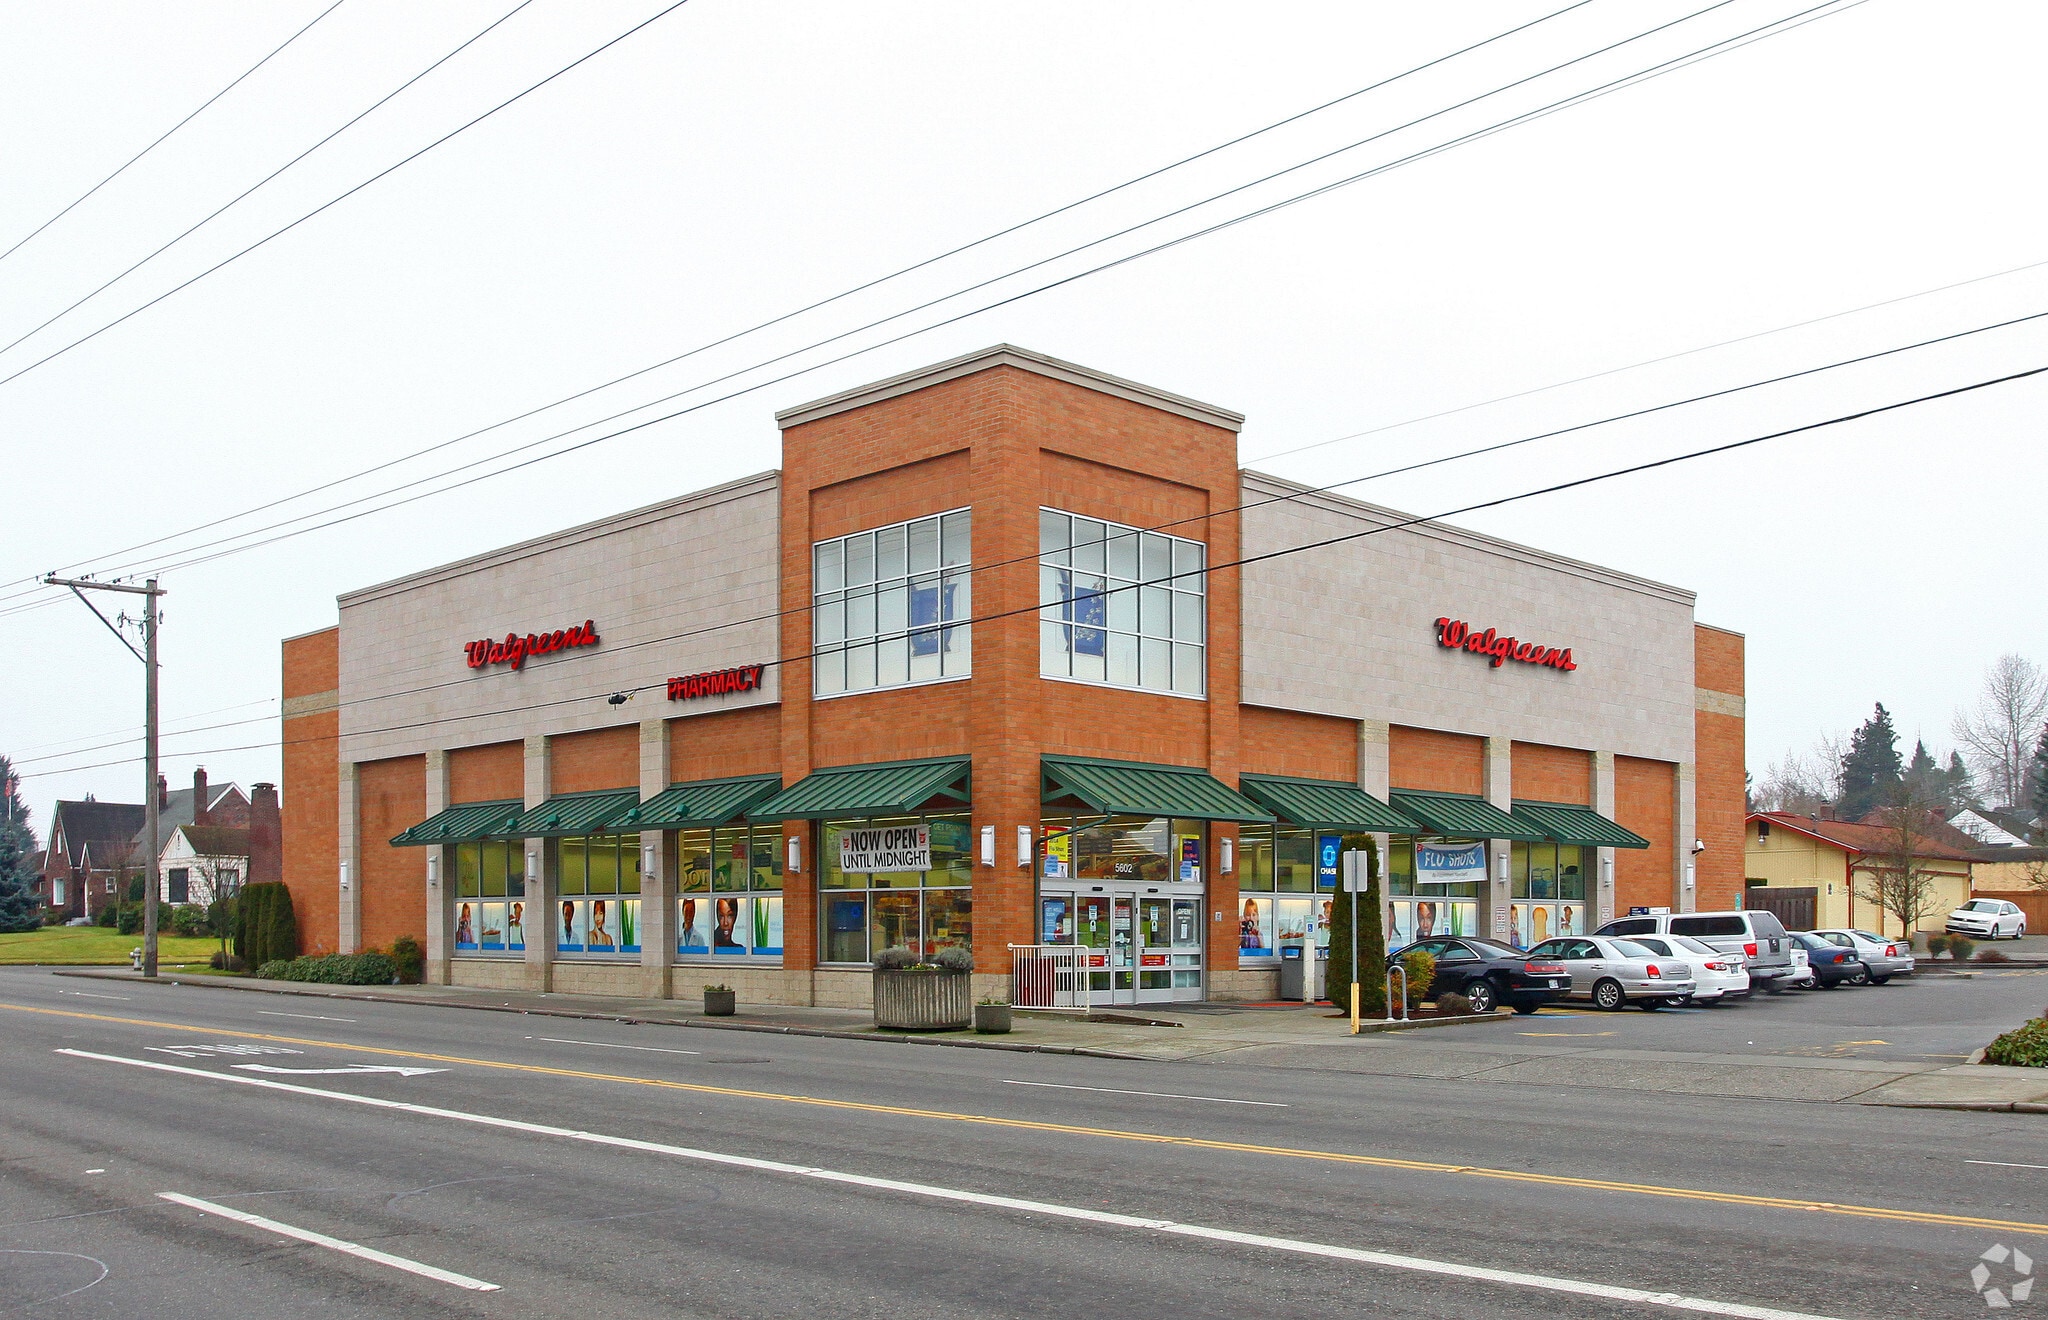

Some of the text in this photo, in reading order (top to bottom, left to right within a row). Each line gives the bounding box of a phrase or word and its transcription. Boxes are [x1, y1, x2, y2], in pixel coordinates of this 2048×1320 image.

[464, 619, 600, 671] Walgreens
[1434, 616, 1577, 671] Walgreens
[667, 663, 764, 701] PHARMACY
[850, 831, 881, 852] NOW
[885, 828, 918, 850] OPEN
[843, 850, 927, 869] UNTIL MIDNIGHT
[1115, 863, 1133, 873] 5602
[1424, 851, 1476, 867] FLU SHOTS
